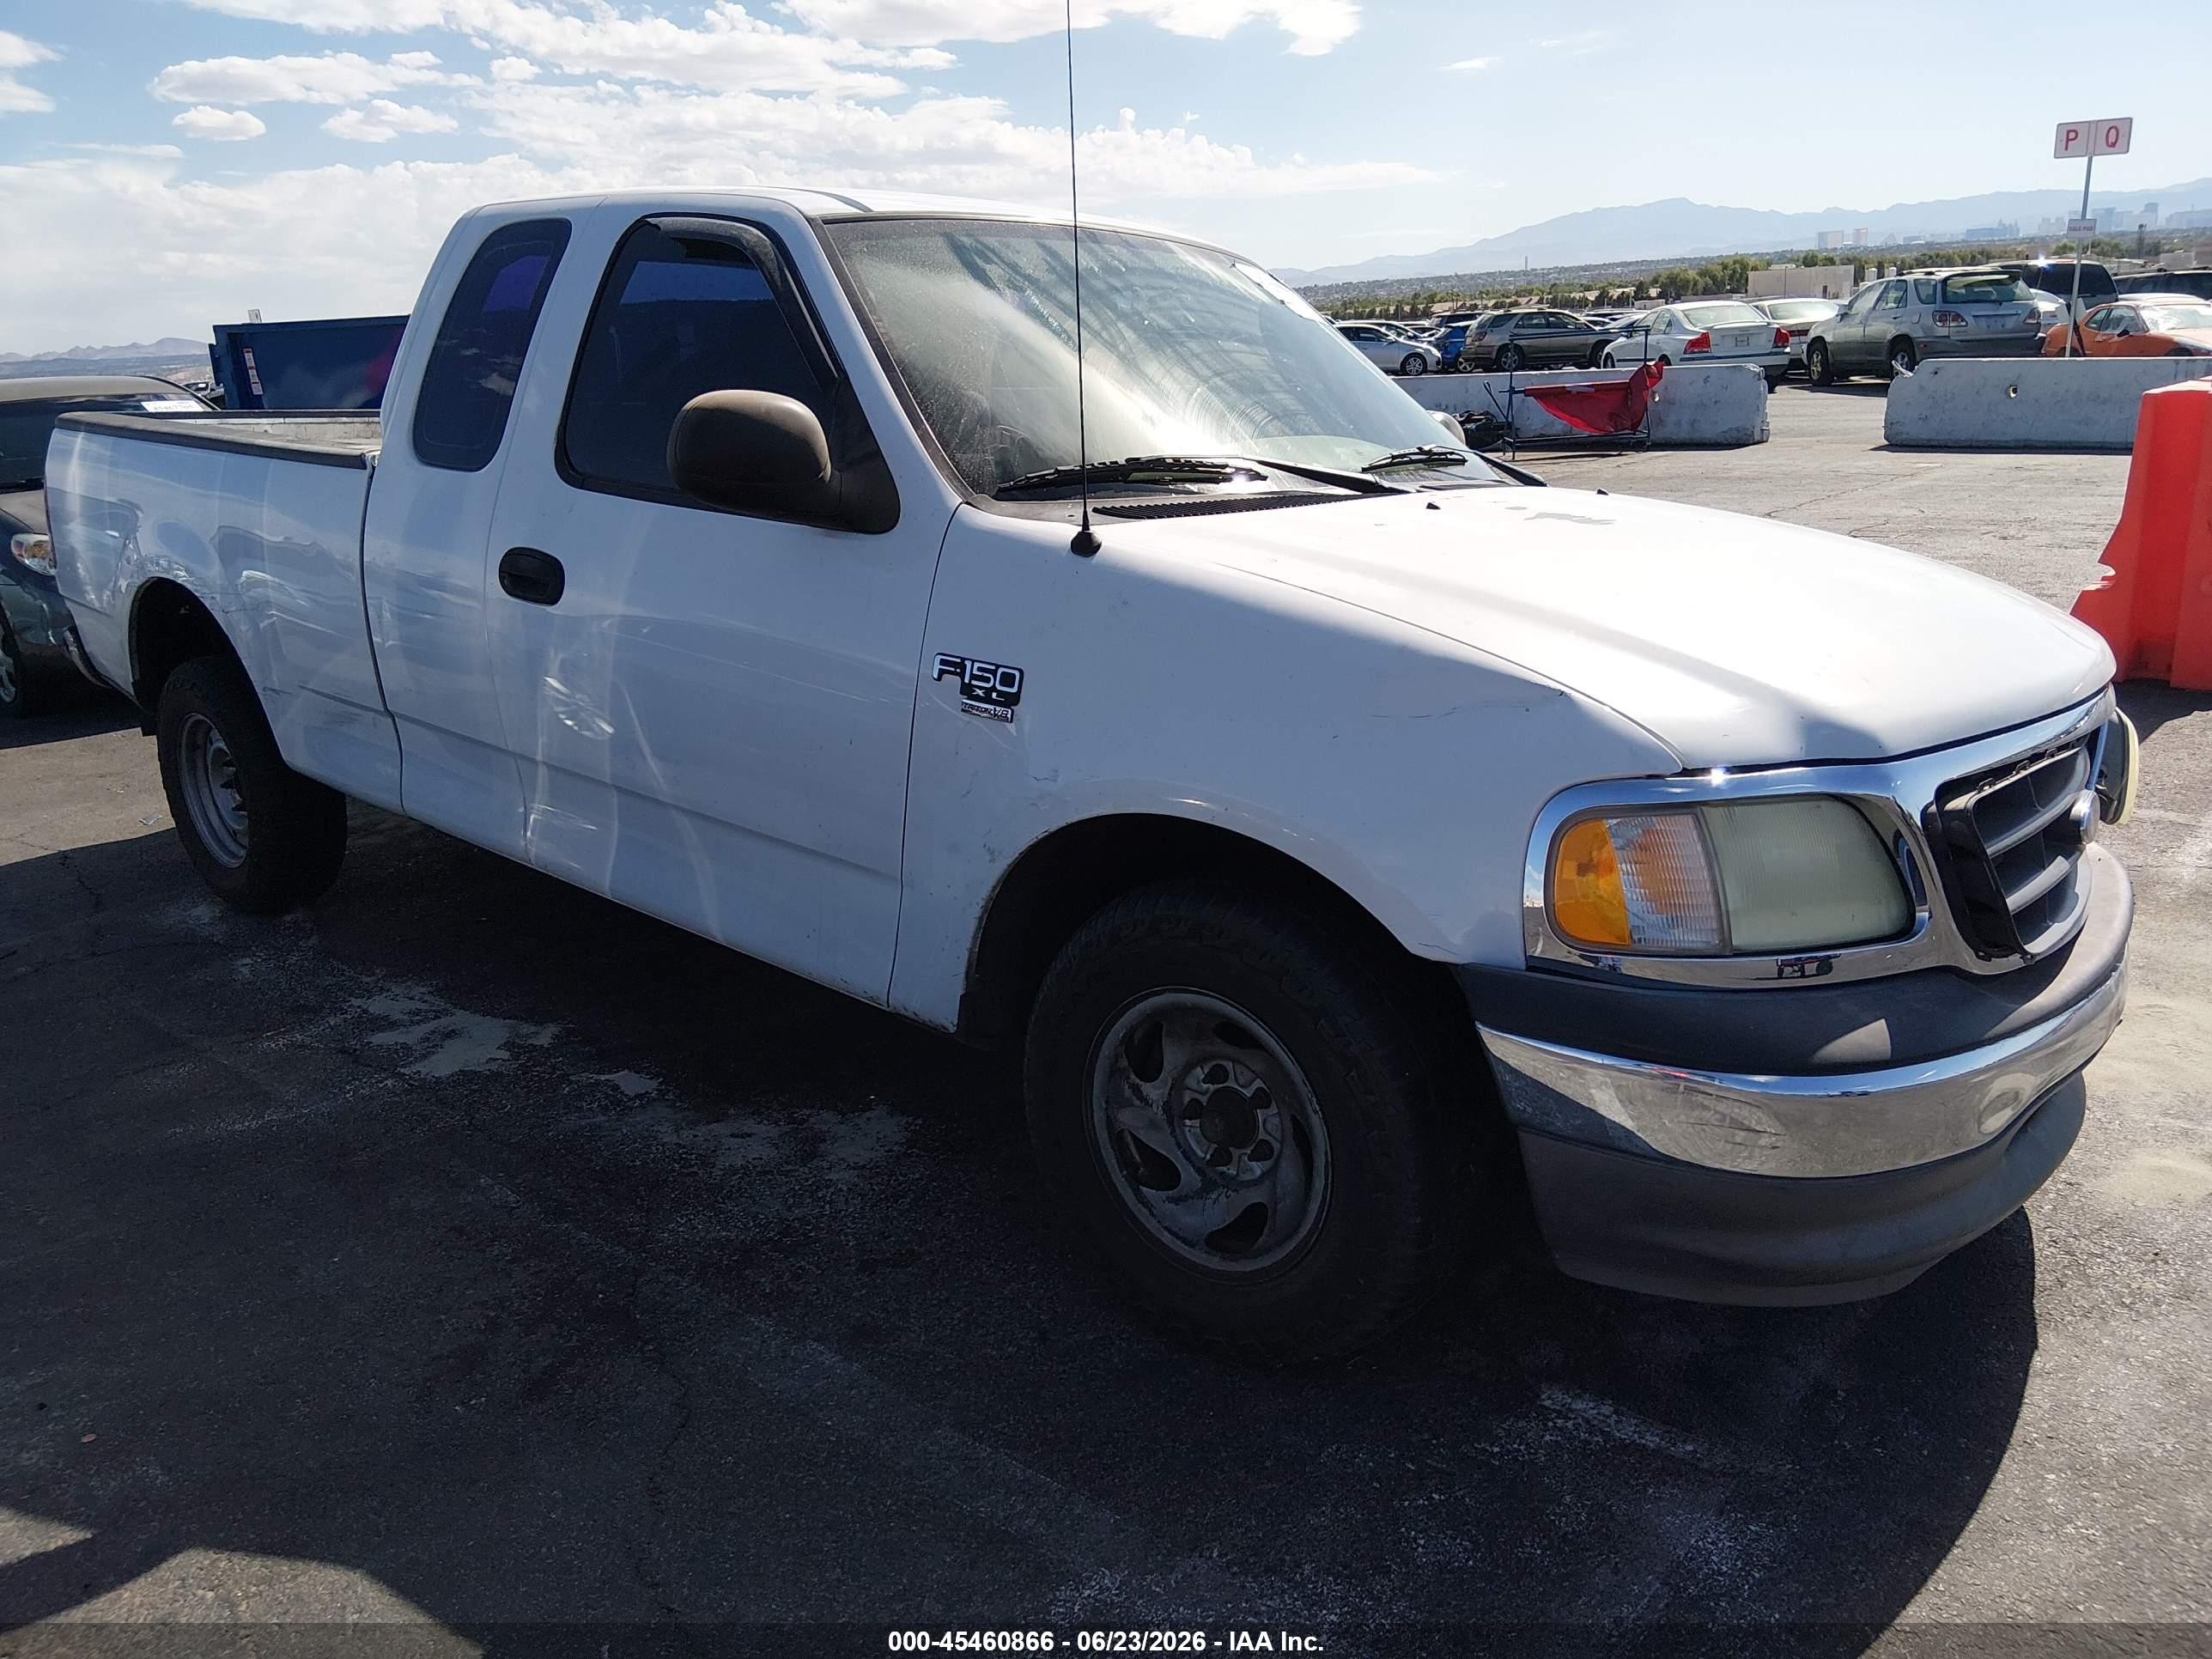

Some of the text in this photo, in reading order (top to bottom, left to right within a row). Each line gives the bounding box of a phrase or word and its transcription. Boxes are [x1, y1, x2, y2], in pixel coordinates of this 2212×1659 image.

[2064, 125, 2119, 151] P Q
[971, 688, 1006, 702] XL
